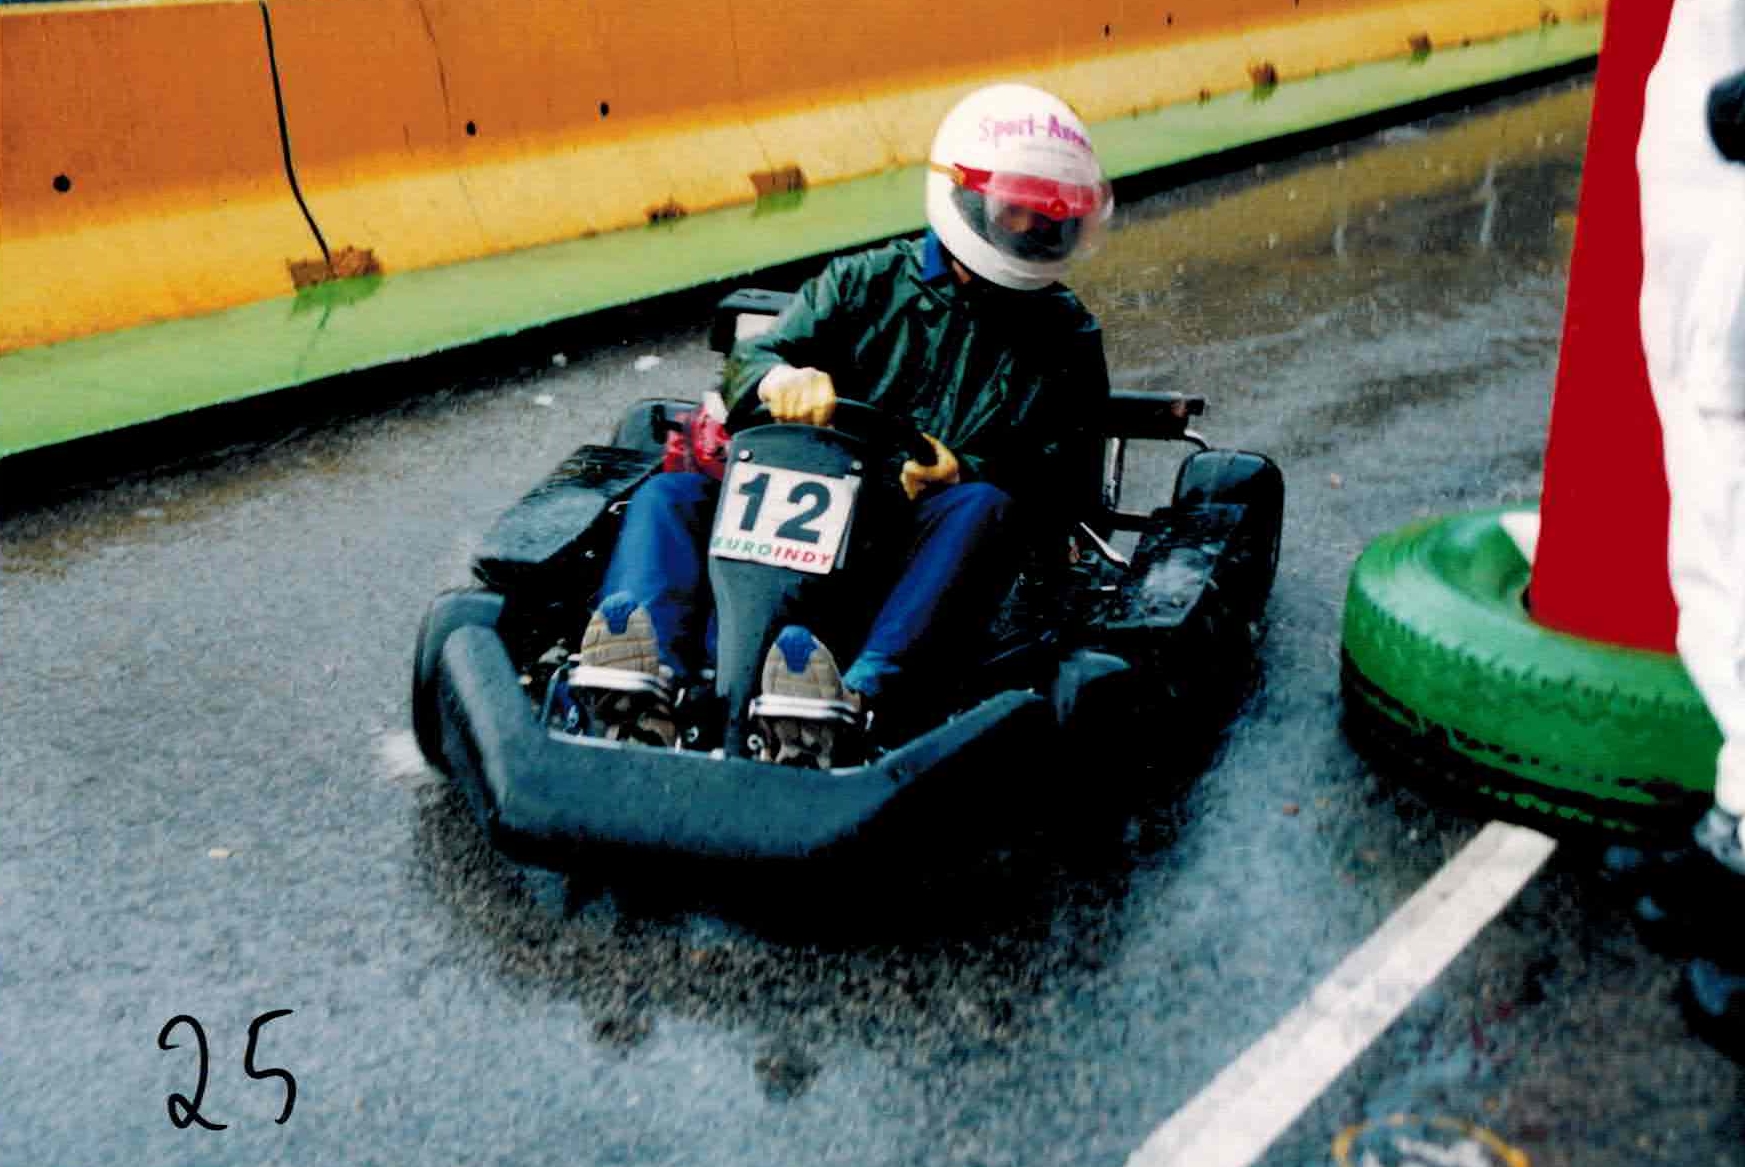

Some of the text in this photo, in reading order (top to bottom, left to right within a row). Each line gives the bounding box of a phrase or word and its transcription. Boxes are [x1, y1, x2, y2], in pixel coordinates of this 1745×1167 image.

[738, 472, 831, 544] 12
[712, 536, 833, 566] EUROINDY
[158, 1009, 296, 1130] 25
